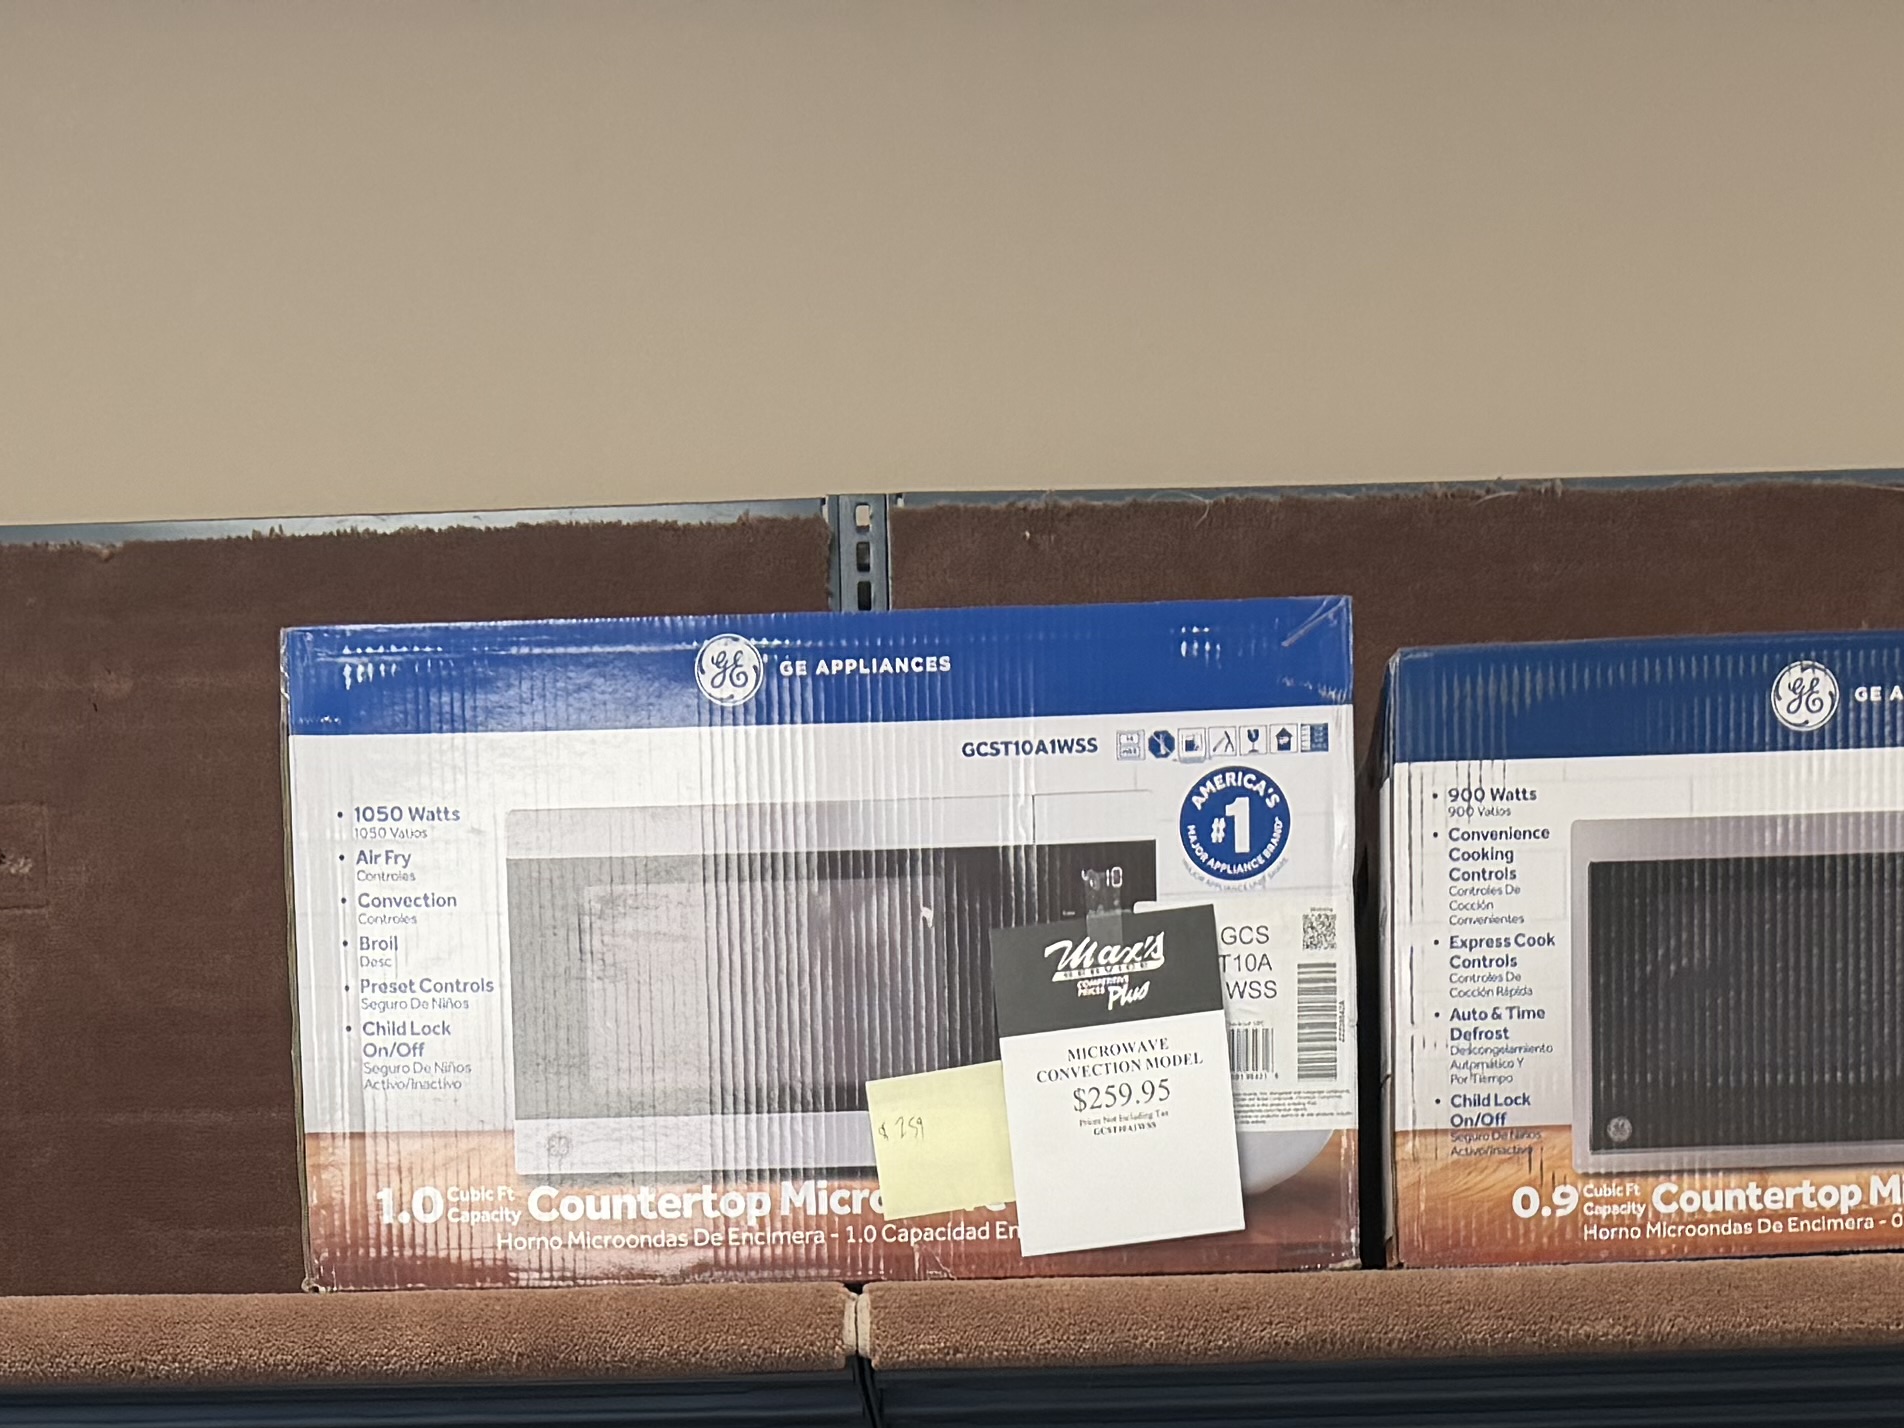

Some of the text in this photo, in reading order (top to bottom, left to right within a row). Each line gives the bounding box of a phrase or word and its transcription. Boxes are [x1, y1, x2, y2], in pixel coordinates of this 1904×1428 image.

[962, 738, 1098, 758] GCST10A1WSS
[355, 806, 460, 822] 1050 Watts
[356, 850, 412, 868] Air Fry
[358, 893, 457, 908] Convection
[360, 936, 398, 950] Broil
[1221, 926, 1270, 944] GCS
[1221, 954, 1273, 972] T10A
[360, 978, 494, 994] Preset Controls
[1067, 1038, 1170, 1062] MICROWAVE
[1036, 1052, 1203, 1083] CONVECTION MODEL
[1073, 1079, 1171, 1113] $259.95
[376, 1186, 773, 1226] 1.0 Countertop
